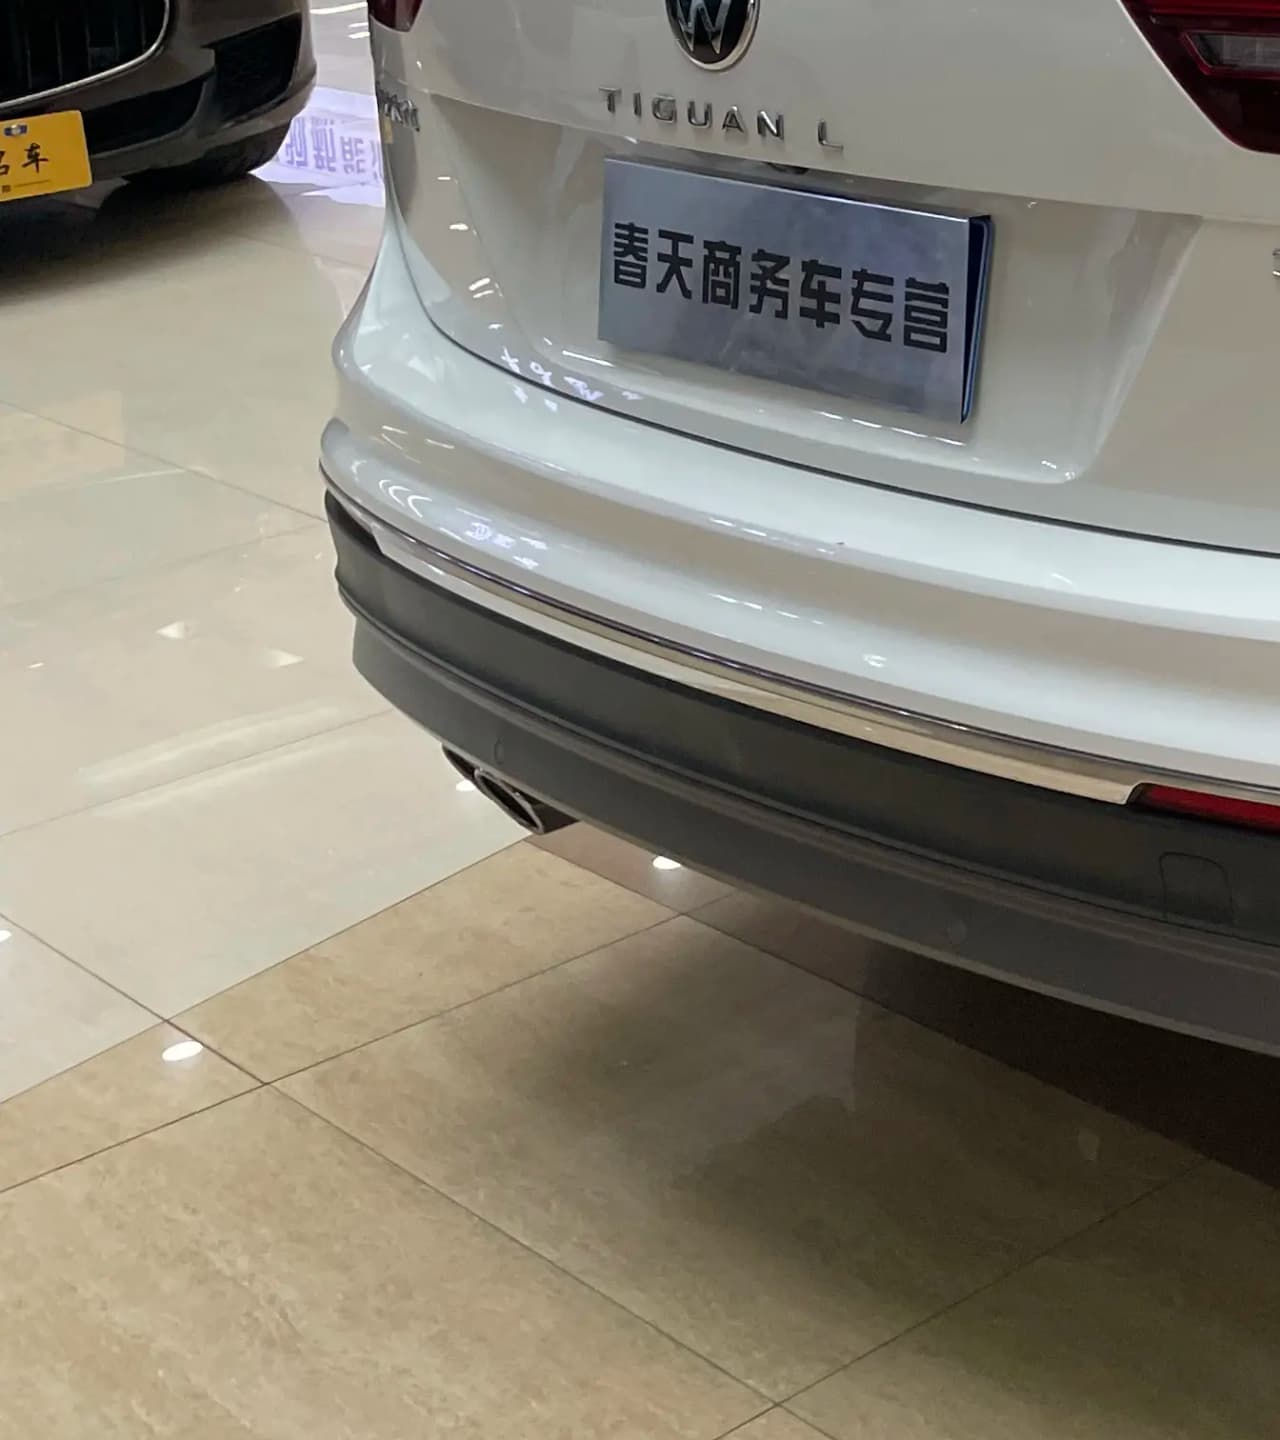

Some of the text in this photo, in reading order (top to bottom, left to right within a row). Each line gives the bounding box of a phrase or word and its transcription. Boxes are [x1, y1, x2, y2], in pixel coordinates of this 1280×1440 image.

[599, 86, 844, 152] TIGUAN L
[613, 221, 950, 354] 春天商务车专营
